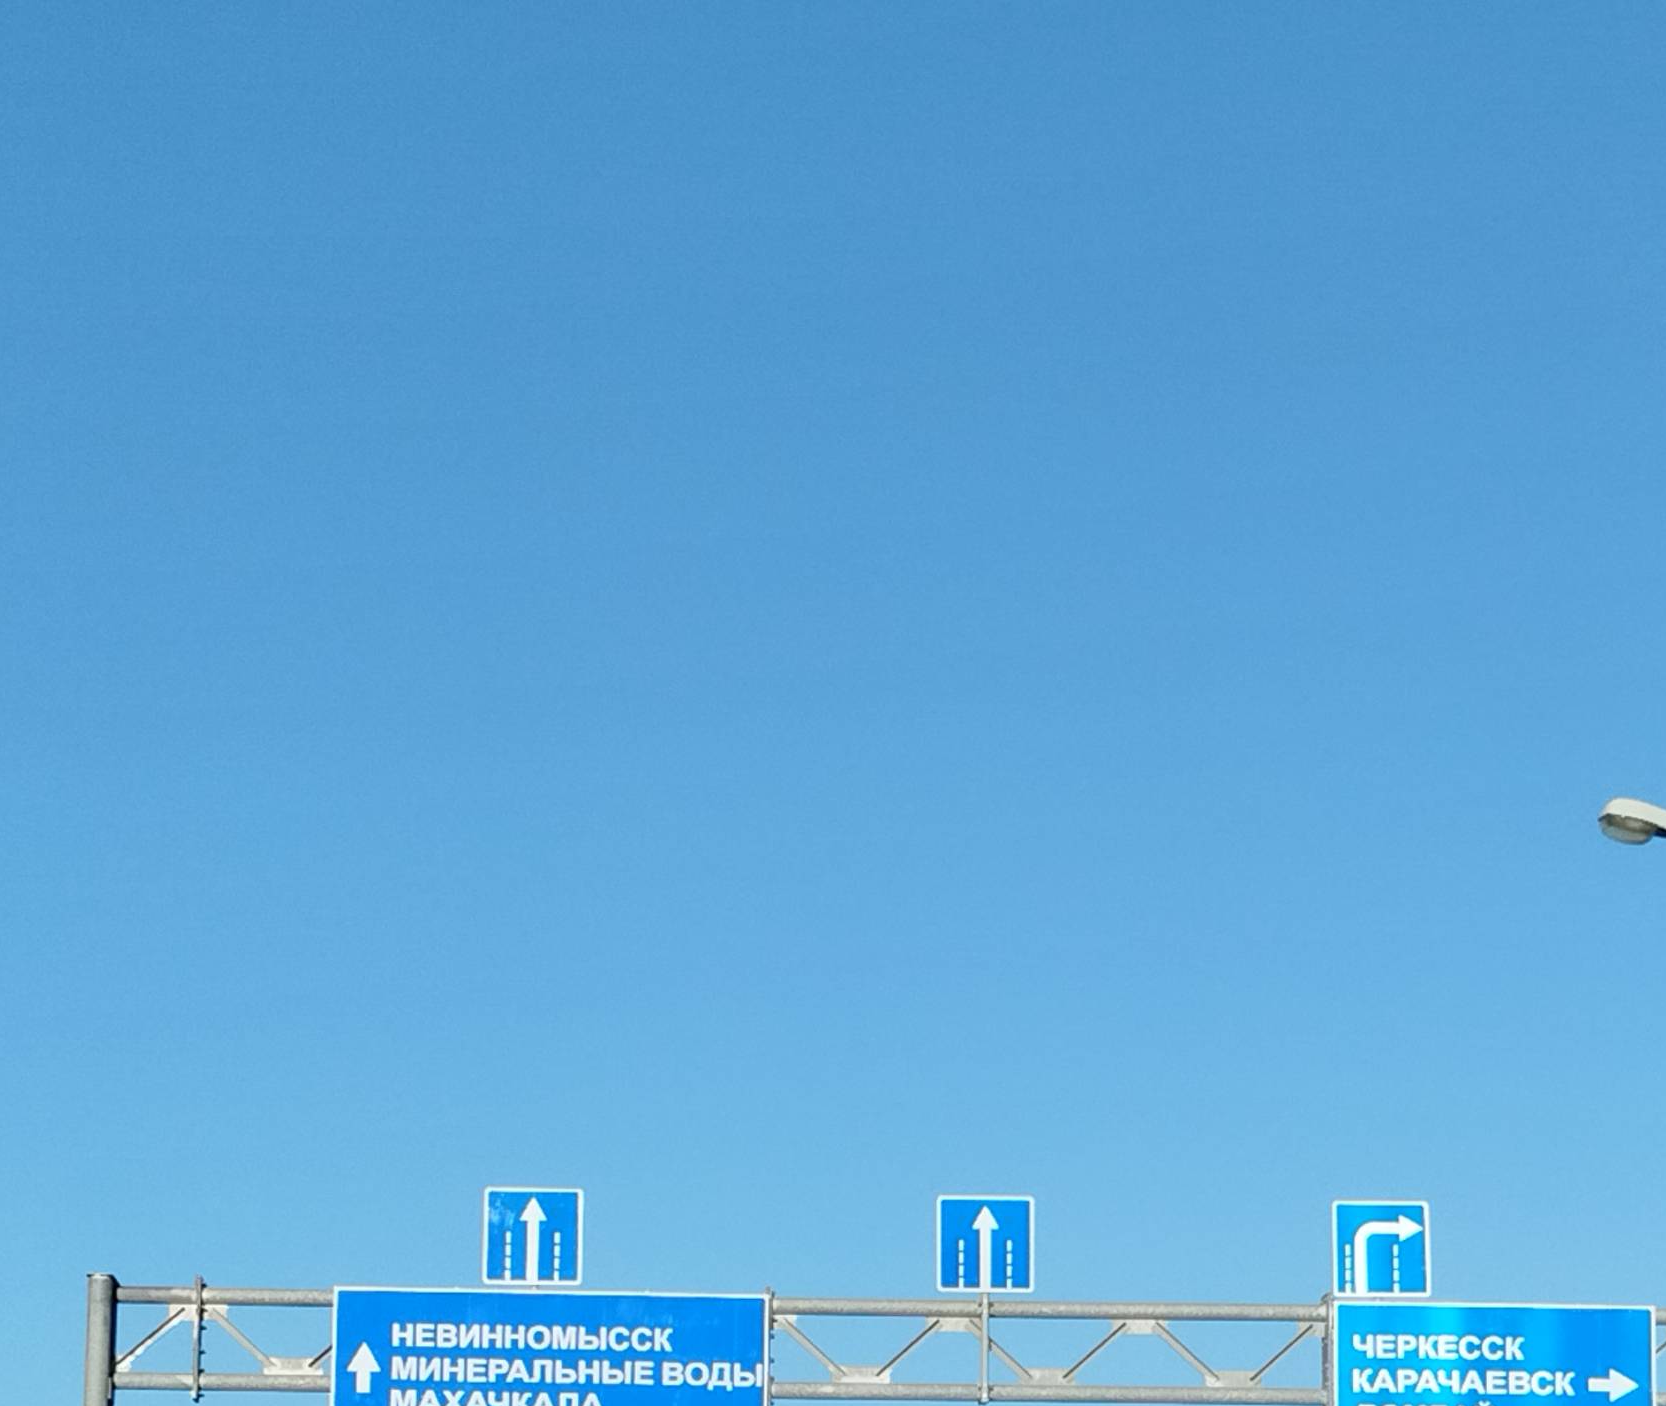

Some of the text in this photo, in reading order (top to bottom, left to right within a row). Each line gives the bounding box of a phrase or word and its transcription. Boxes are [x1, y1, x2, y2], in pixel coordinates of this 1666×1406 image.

[390, 1322, 673, 1352] НЕВИННОМЫССК
[1352, 1333, 1525, 1360] ЧЕРКЕССК
[390, 1356, 763, 1391] МИНЕРАЛЬНЫЕ ВОДЫ
[1352, 1368, 1575, 1395] КАРАЧАЕВСК
